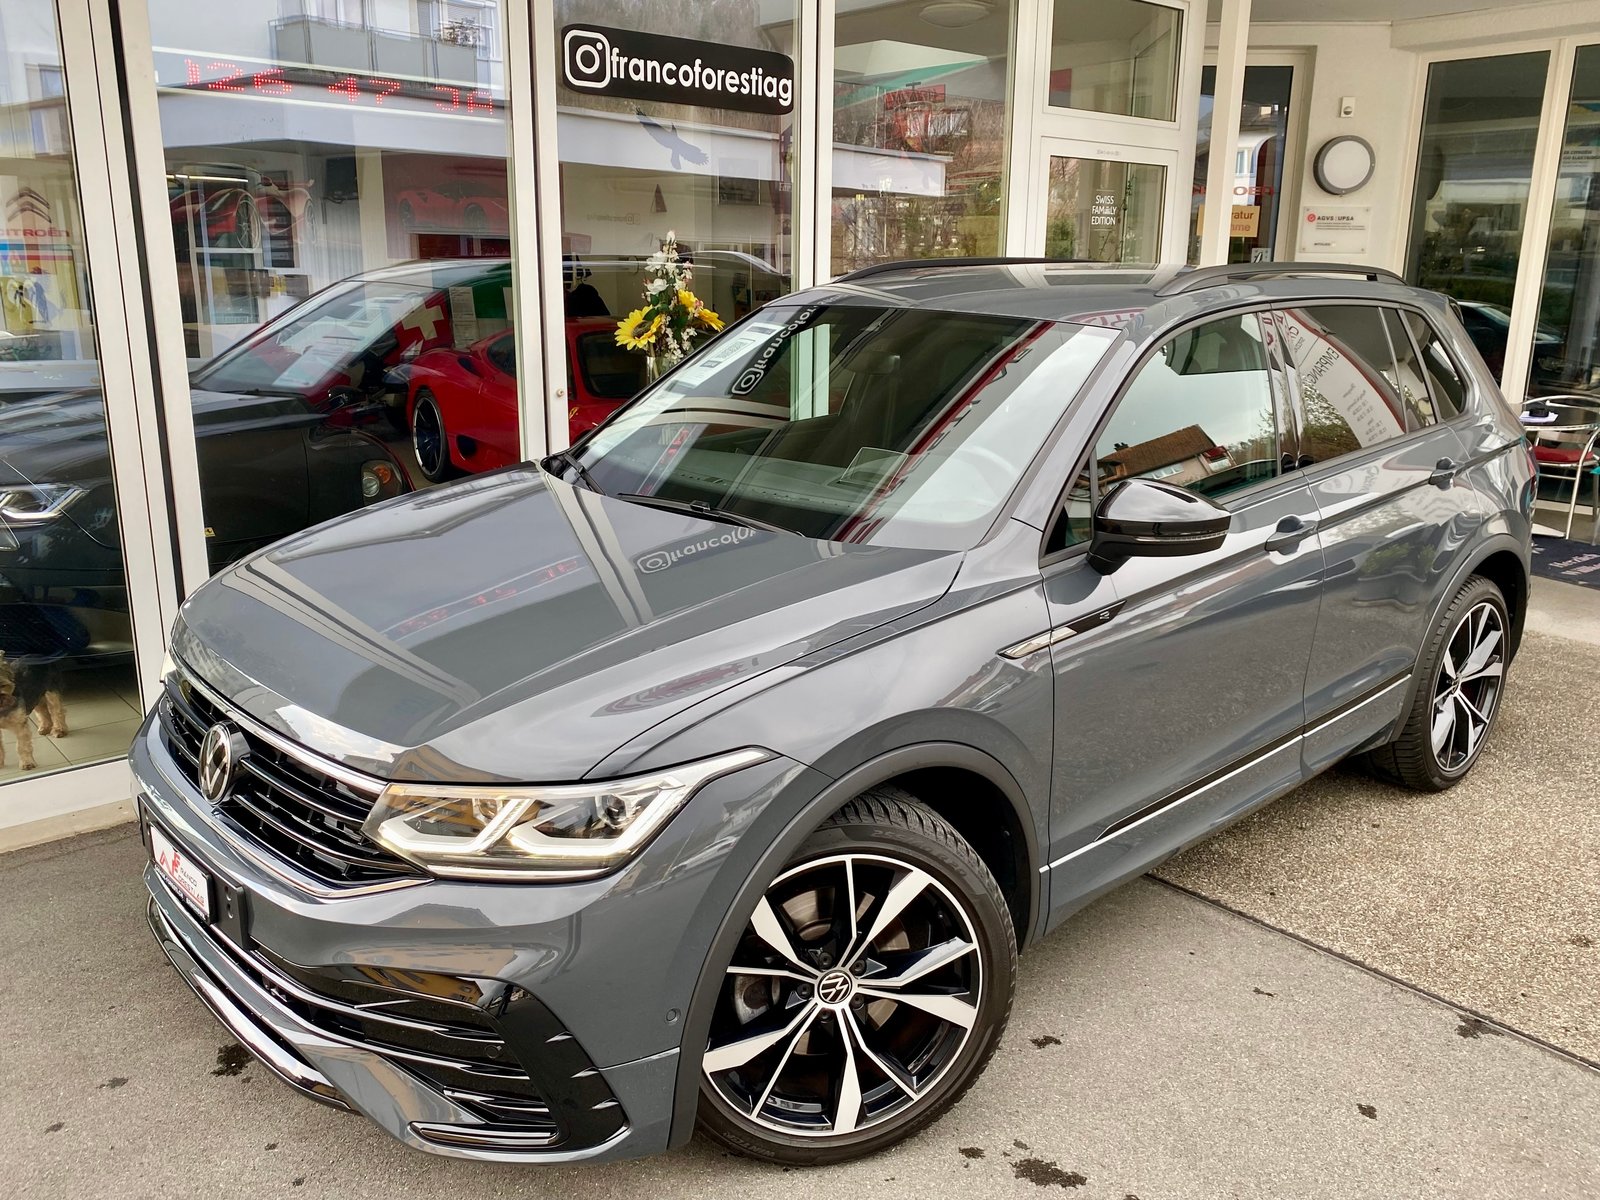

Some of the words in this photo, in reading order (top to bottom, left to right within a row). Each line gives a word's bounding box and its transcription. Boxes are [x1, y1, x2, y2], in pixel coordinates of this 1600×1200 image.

[611, 47, 793, 107] francoforestiag
[328, 76, 401, 104] 47
[1095, 194, 1115, 205] SWISS
[1091, 216, 1117, 226] EDITION
